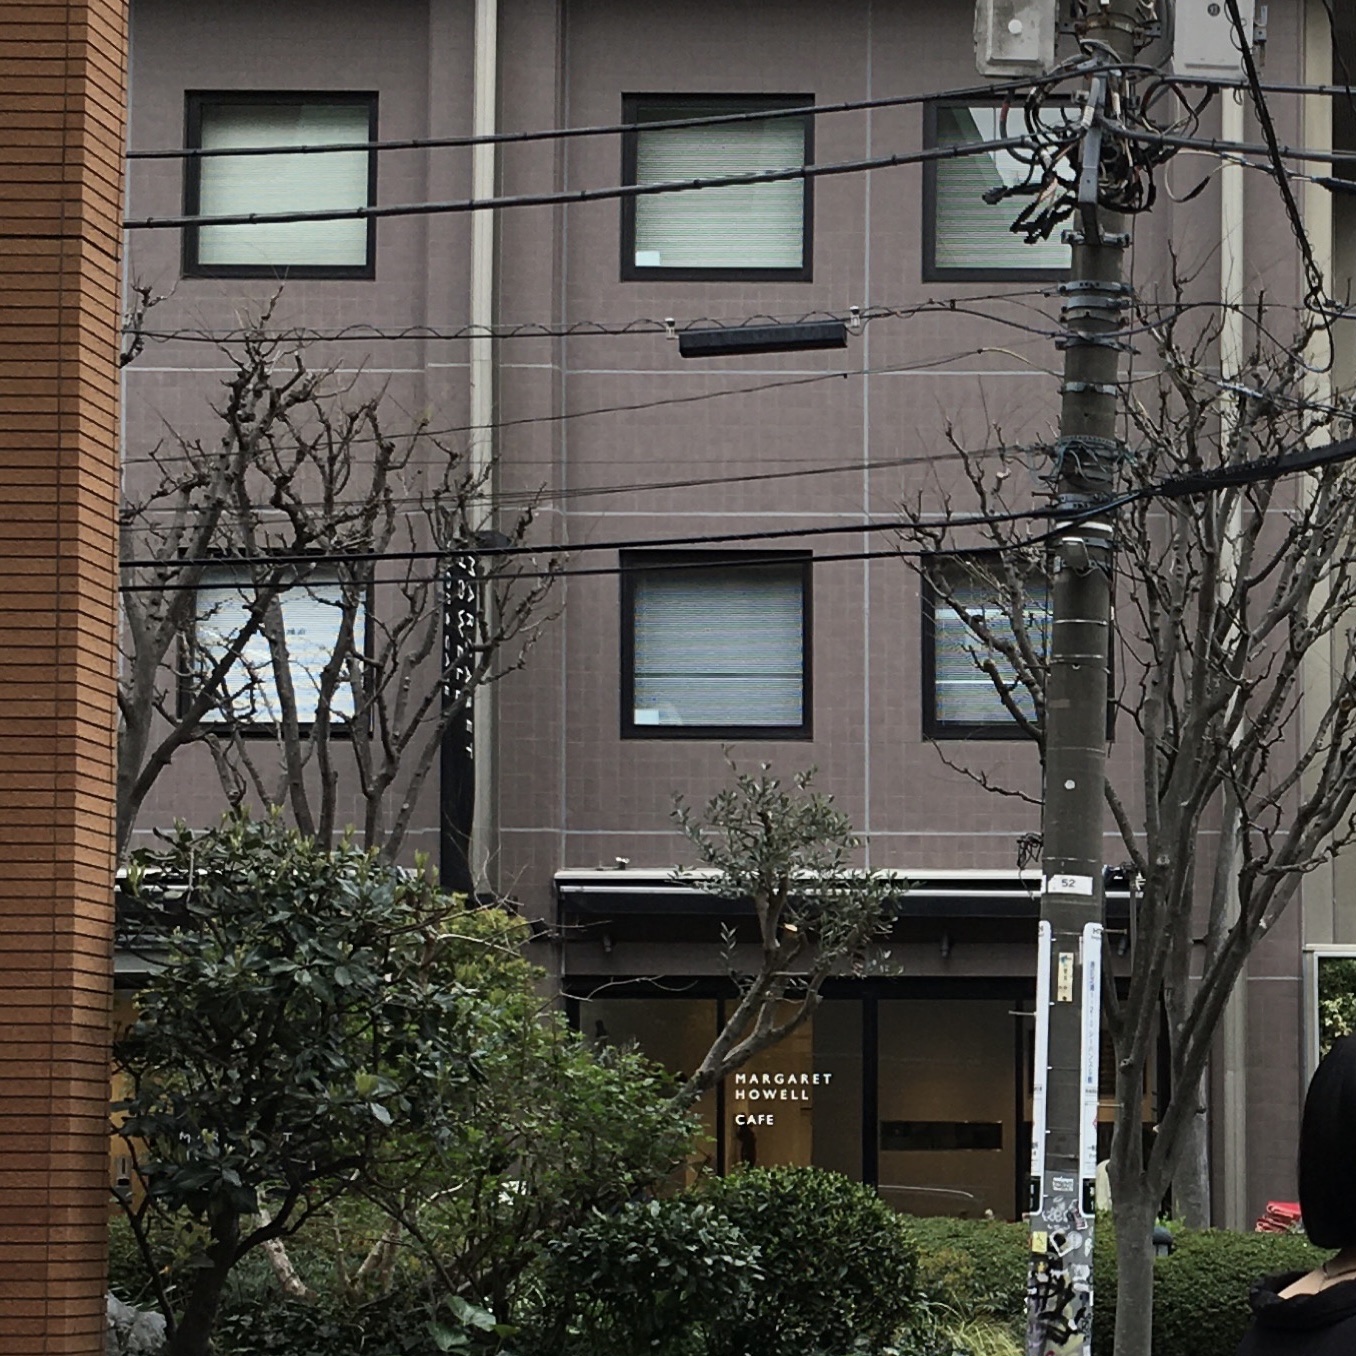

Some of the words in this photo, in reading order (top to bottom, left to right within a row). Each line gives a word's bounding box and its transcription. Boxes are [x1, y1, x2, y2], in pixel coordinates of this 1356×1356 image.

[1061, 878, 1076, 888] 52
[735, 1073, 832, 1085] MARGARET
[735, 1089, 809, 1100] HOWELL
[735, 1114, 774, 1126] CAFE
